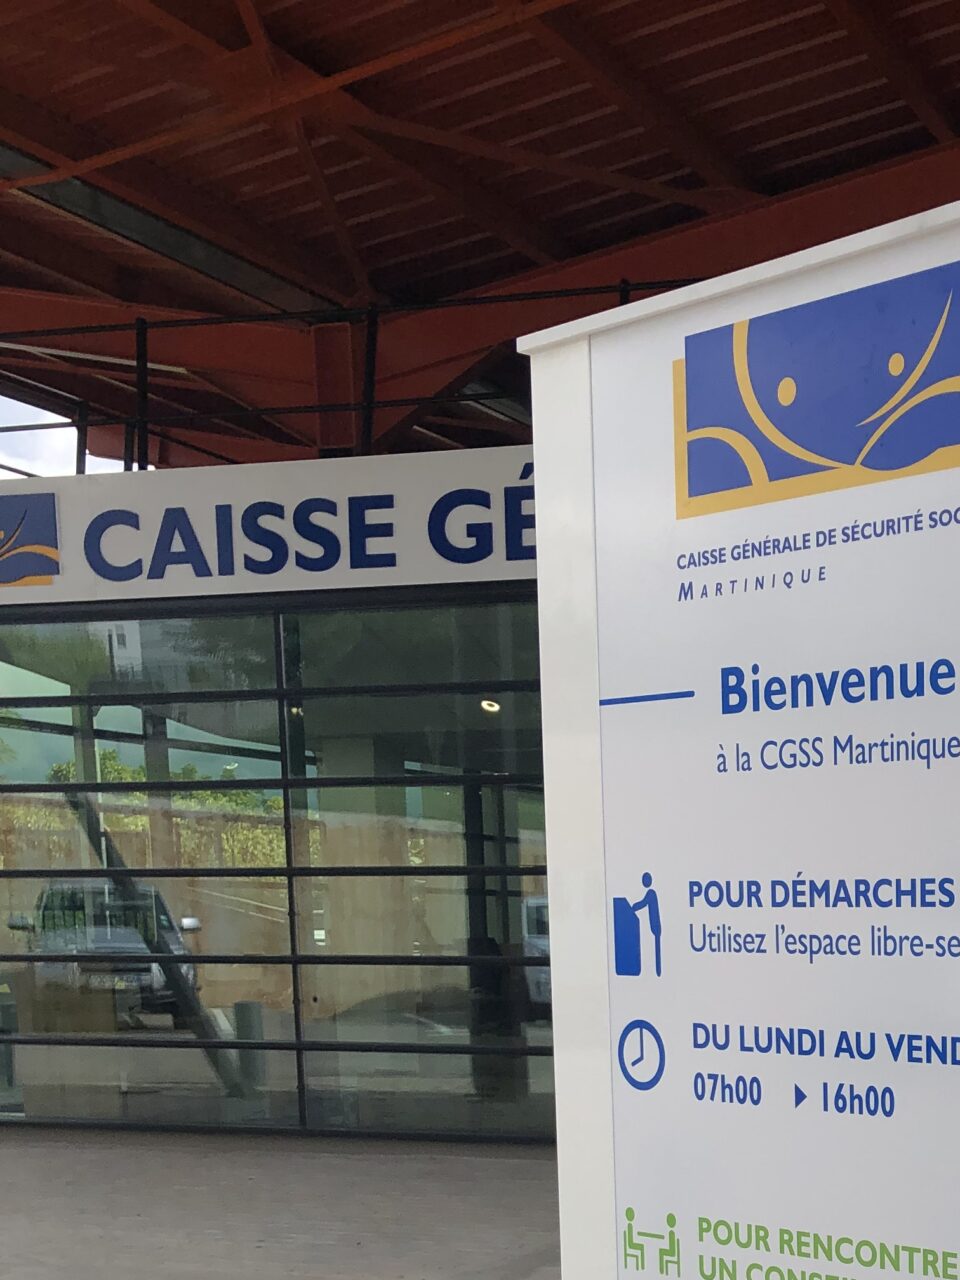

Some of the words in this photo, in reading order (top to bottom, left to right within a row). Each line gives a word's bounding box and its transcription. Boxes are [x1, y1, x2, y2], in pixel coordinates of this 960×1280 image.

[83, 494, 397, 582] CAISSE
[676, 547, 726, 570] CAISSE
[730, 533, 811, 562] GÉNÉRALE
[815, 529, 837, 547] DE
[841, 508, 924, 543] SÉCURITÉ
[677, 566, 827, 602] MARTINIQUE
[720, 657, 956, 715] Bienvenue
[716, 744, 727, 773] à
[736, 742, 752, 772] la
[760, 736, 823, 771] CGSS
[688, 880, 764, 908] POUR
[770, 872, 956, 908] DÉMARCHES
[689, 923, 767, 954] Utilisez
[692, 1022, 730, 1050] DU
[739, 1024, 825, 1057] LUNDI
[834, 1031, 876, 1061] AU
[692, 1072, 763, 1106] 07h00
[821, 1082, 895, 1118] 16h00
[698, 1217, 771, 1252] POUR
